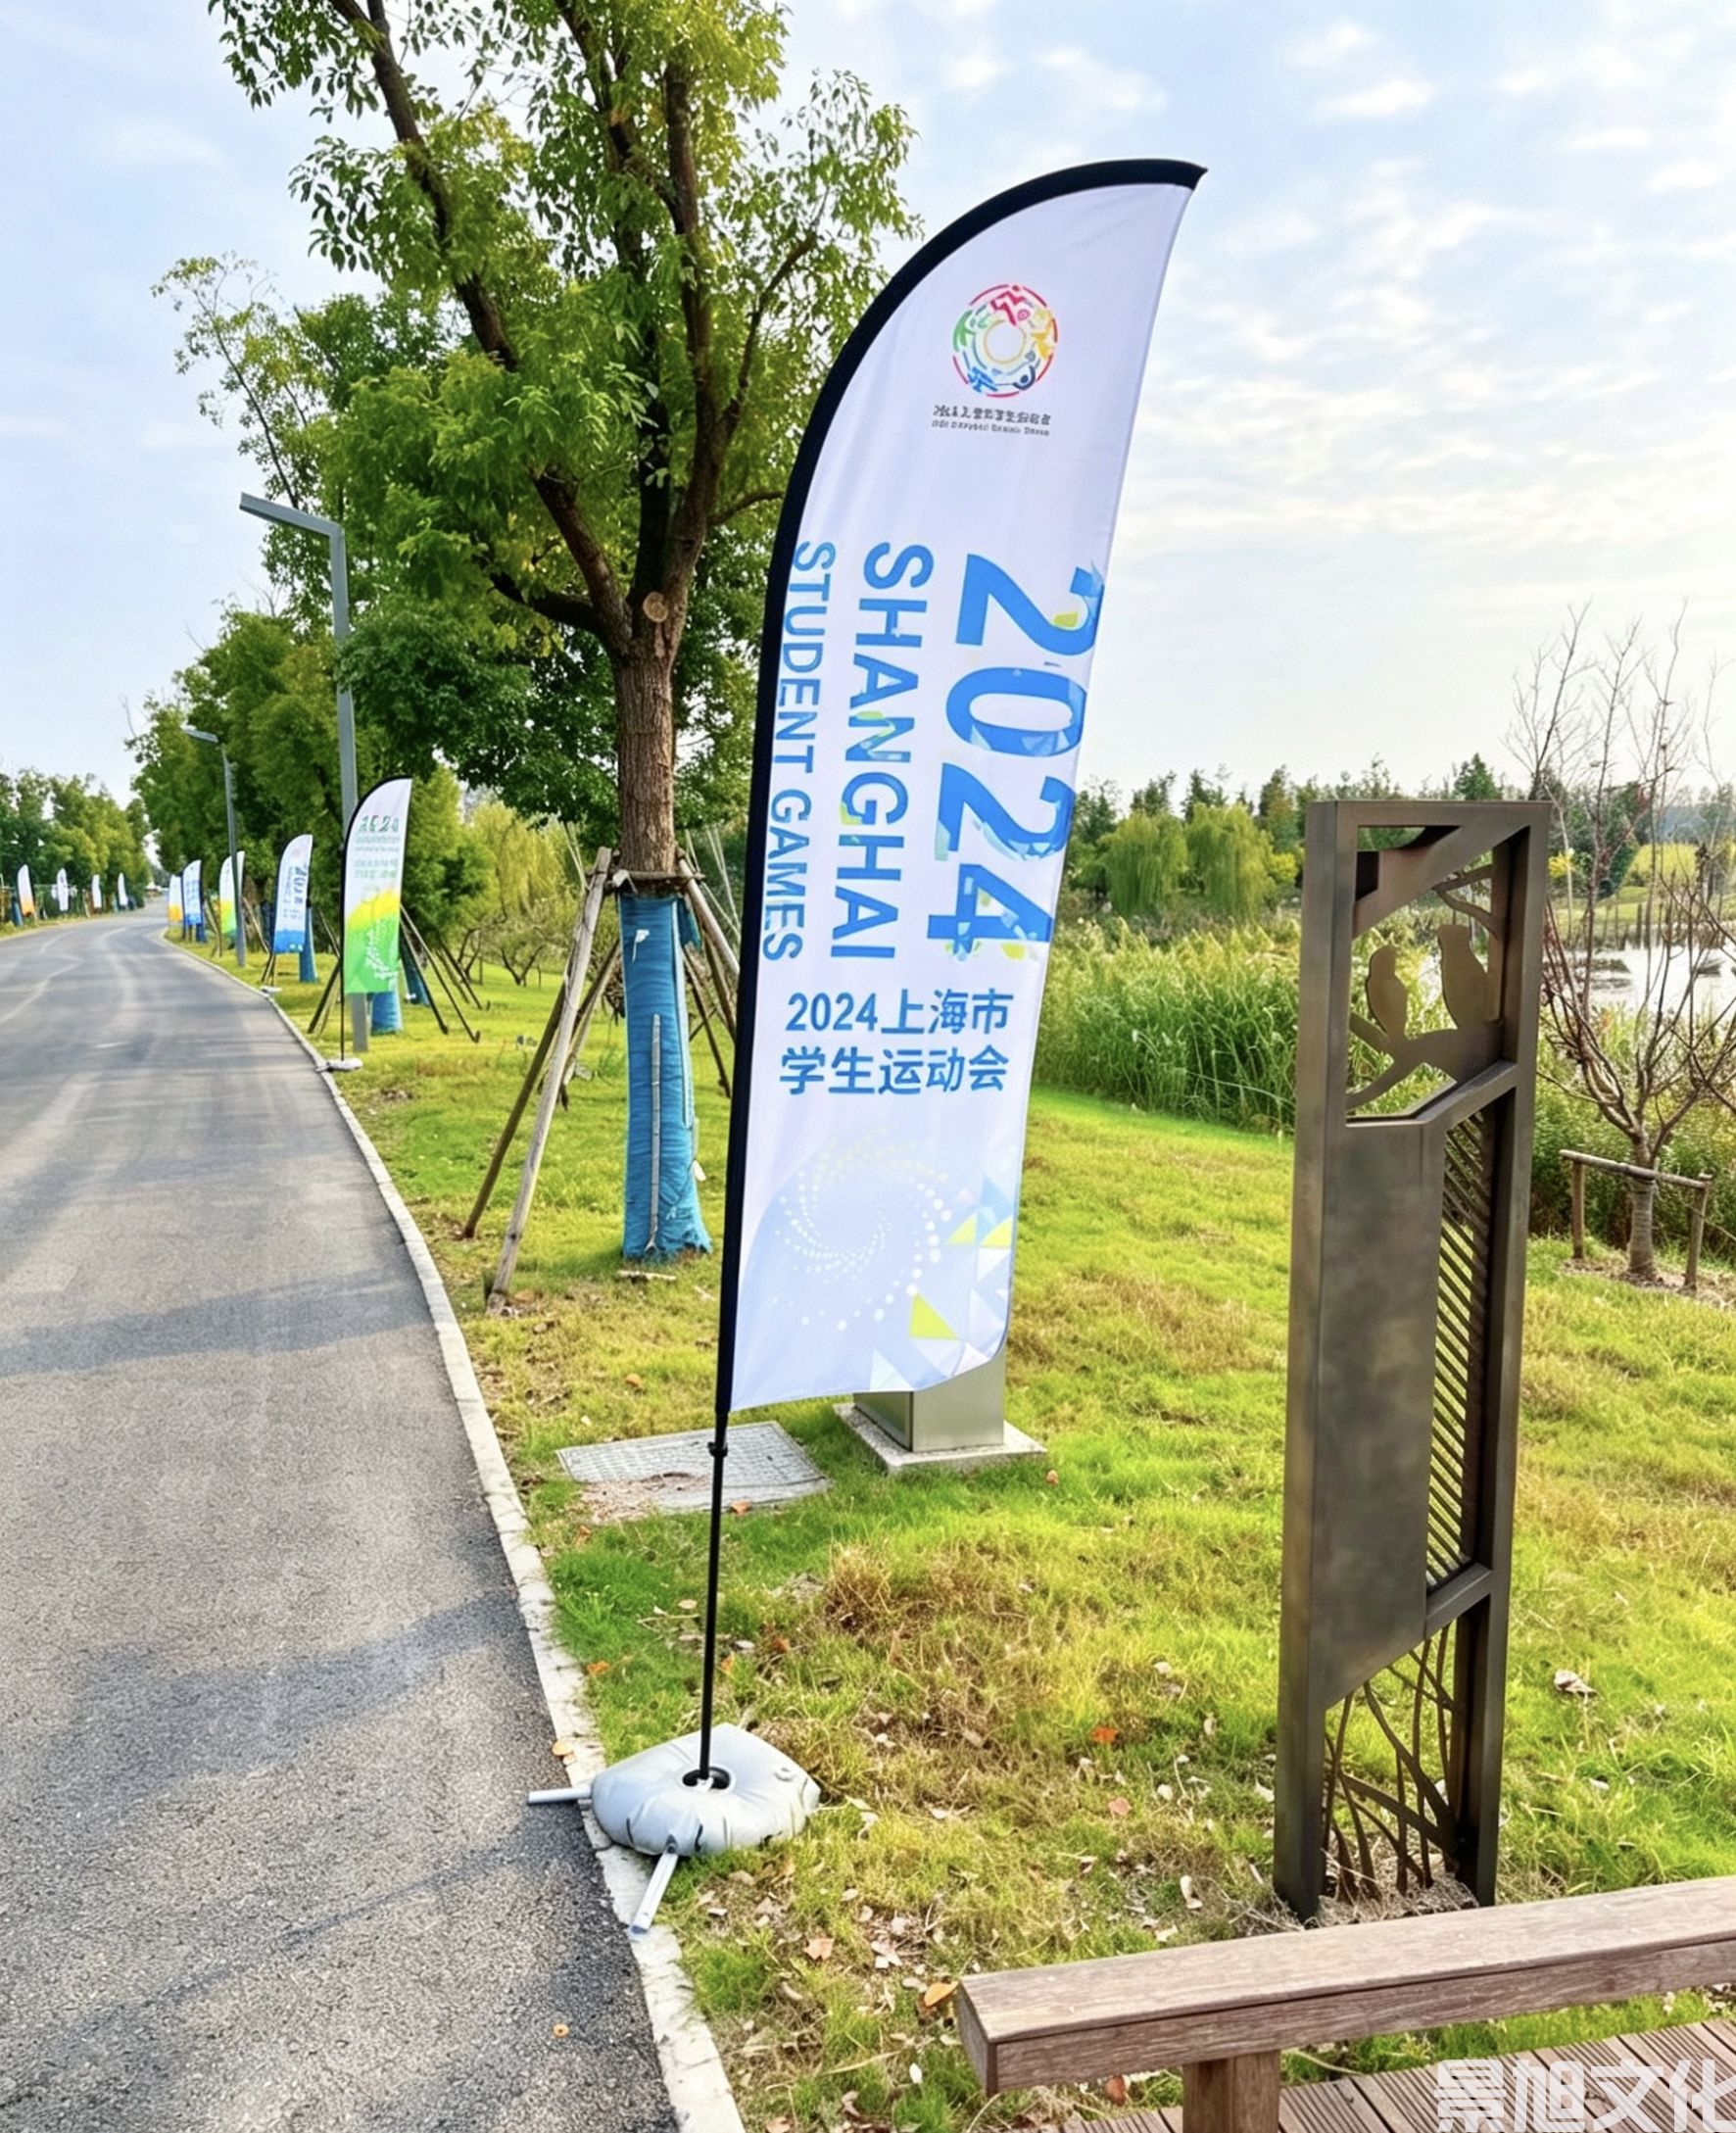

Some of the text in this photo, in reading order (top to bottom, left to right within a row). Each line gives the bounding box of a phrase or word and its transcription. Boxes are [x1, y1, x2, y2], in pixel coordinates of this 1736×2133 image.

[761, 540, 837, 961] STUDENT GAMES
[831, 541, 935, 958] SHANGHAI
[927, 554, 1105, 956] 2024
[779, 1044, 1010, 1095] 学生运动会
[785, 988, 1015, 1035] 2024上海市
